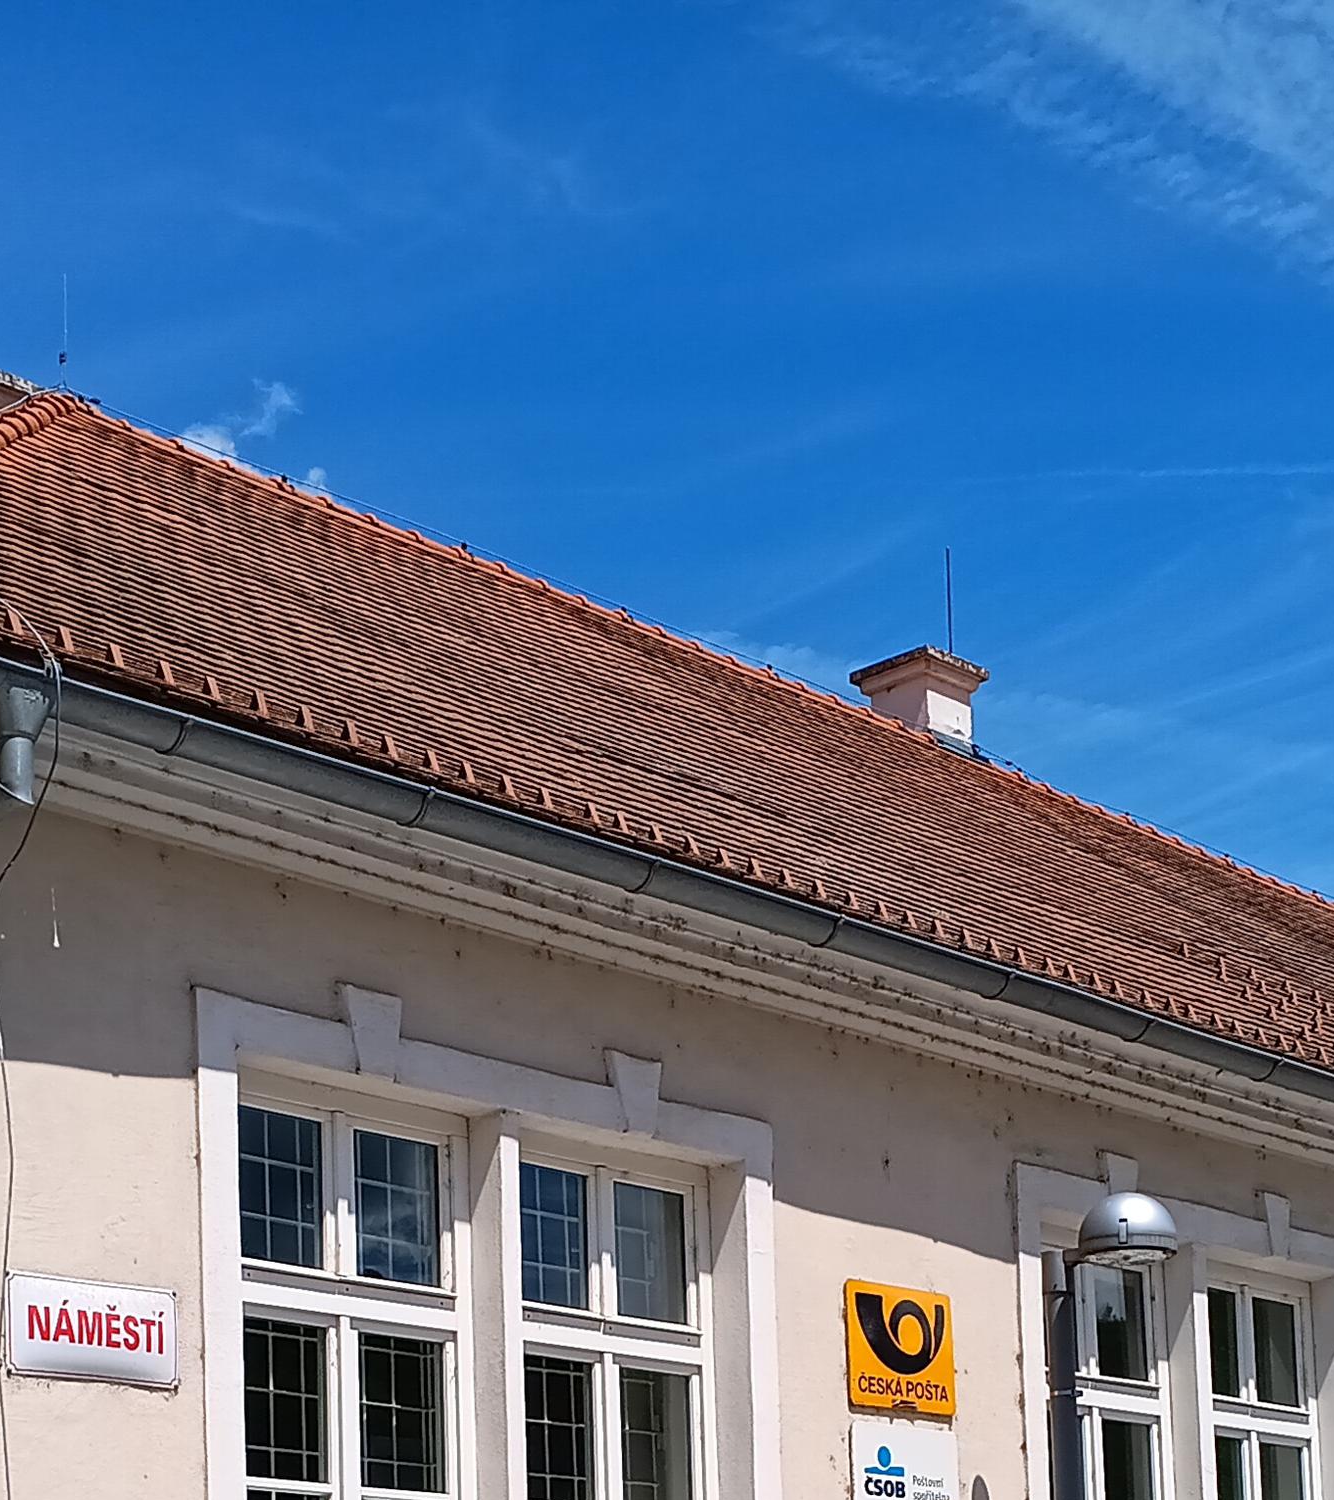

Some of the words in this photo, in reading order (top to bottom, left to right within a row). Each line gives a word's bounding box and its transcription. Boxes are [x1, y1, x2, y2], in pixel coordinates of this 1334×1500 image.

[28, 1299, 165, 1355] NÁMĚSTÍ
[858, 1372, 904, 1397] ČESKÁ
[906, 1380, 949, 1403] POŠTA
[864, 1475, 906, 1498] ČSOB
[912, 1475, 944, 1488] Poštovní
